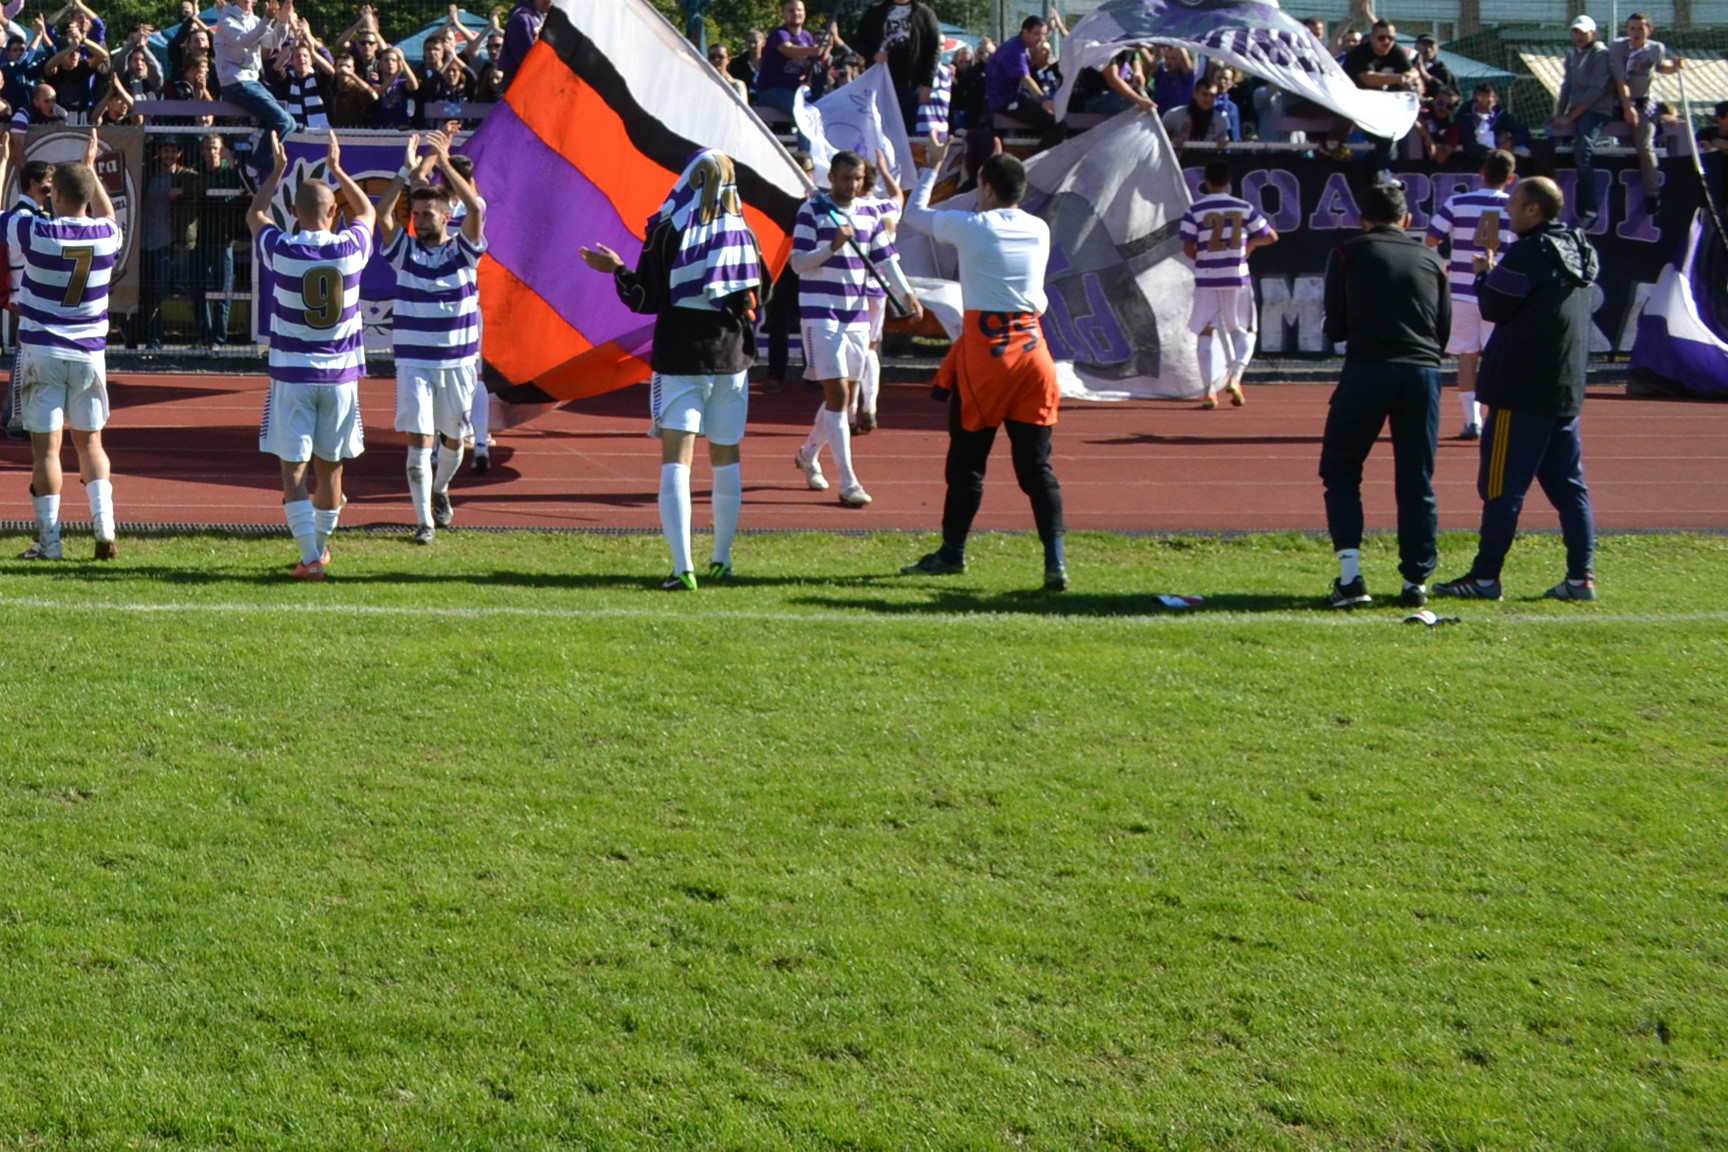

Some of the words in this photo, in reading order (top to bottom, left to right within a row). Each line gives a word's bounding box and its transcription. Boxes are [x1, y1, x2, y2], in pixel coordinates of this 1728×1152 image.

[1203, 210, 1244, 252] 27
[1473, 210, 1500, 248] 4
[60, 245, 95, 308] 7
[301, 265, 345, 330] 9
